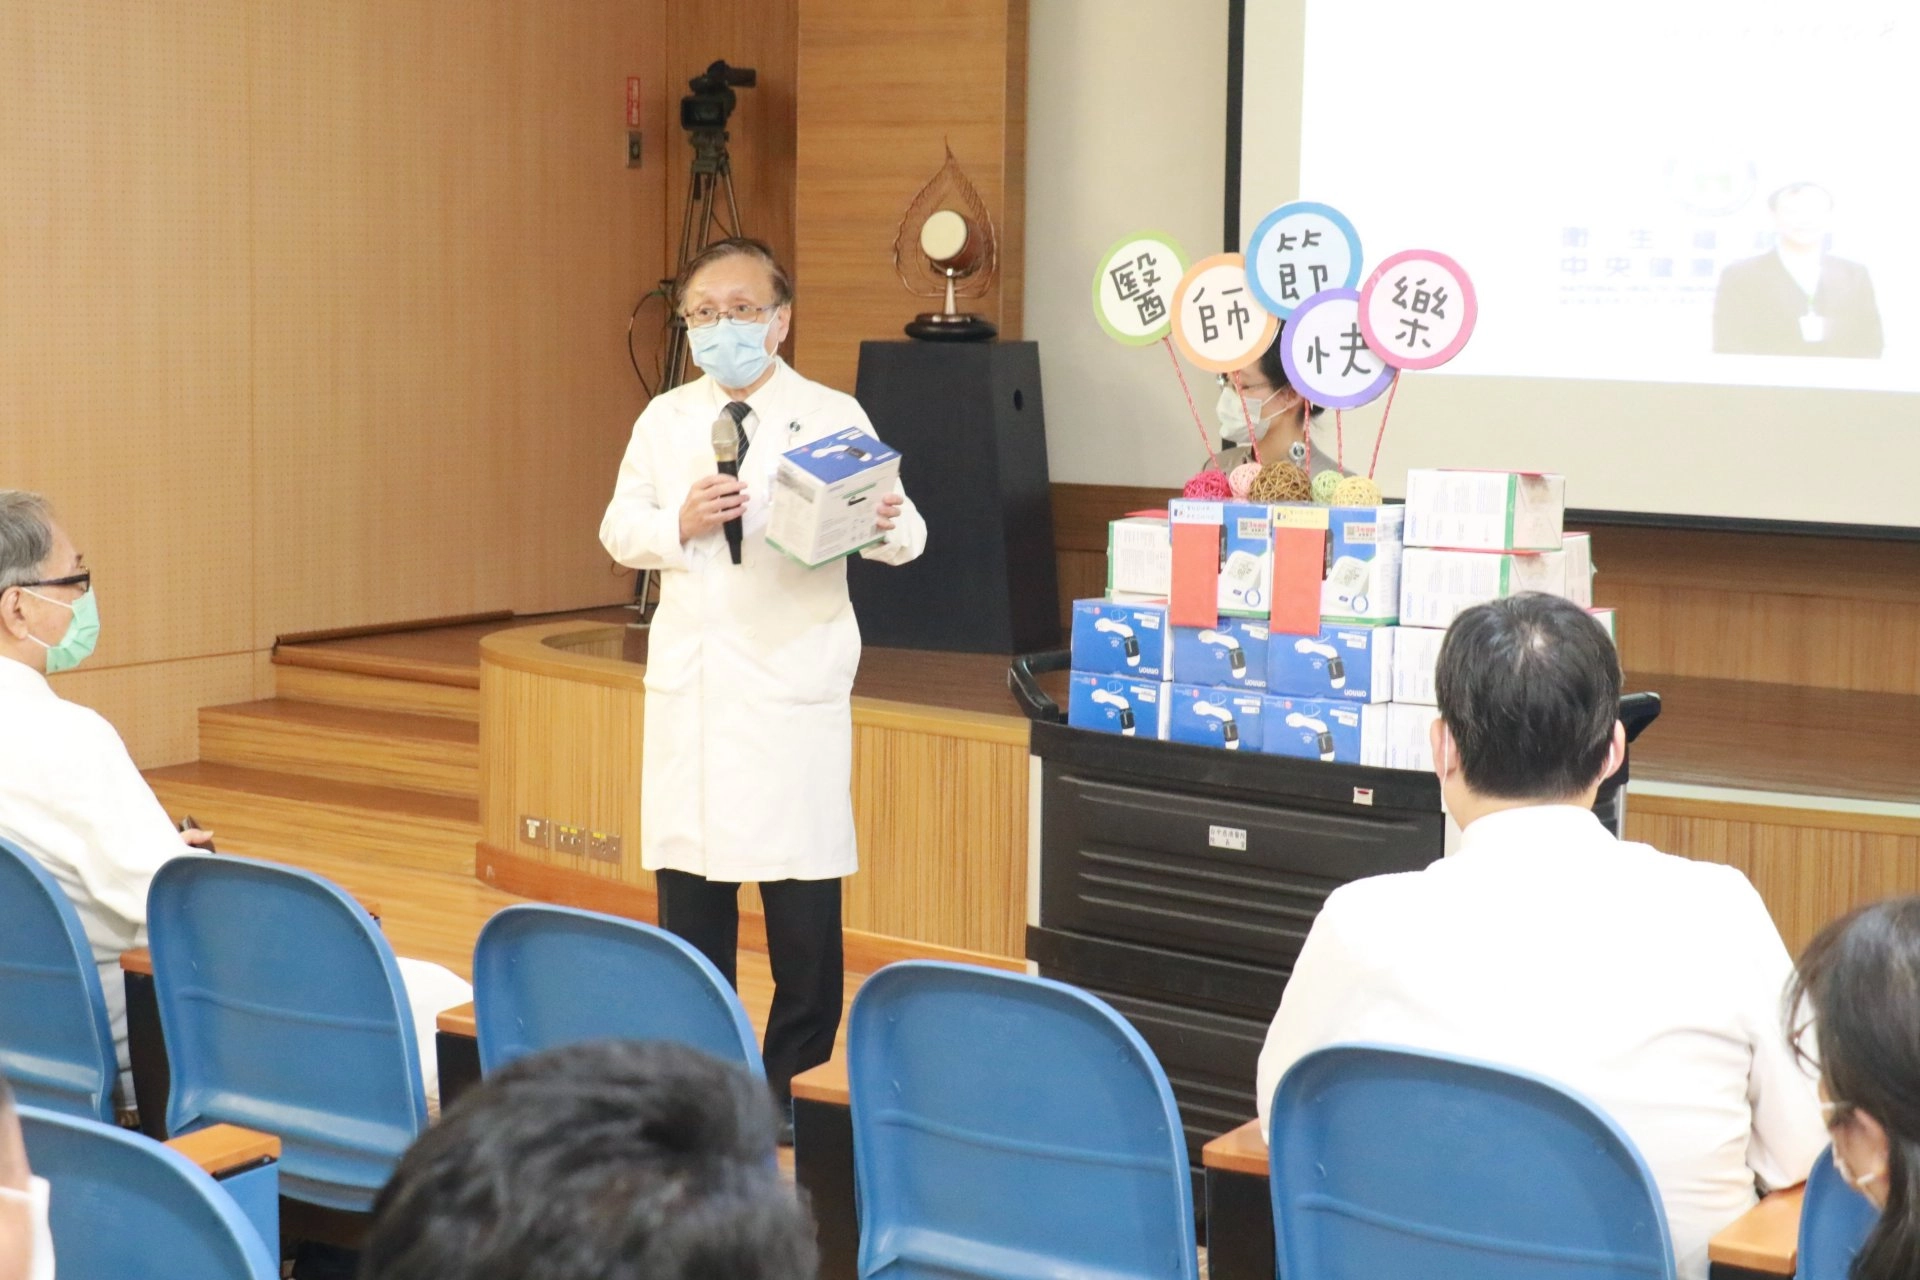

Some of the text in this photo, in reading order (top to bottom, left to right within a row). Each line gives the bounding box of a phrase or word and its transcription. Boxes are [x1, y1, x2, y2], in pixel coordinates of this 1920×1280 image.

[1109, 252, 1168, 326] 醫
[1276, 228, 1330, 301] 節
[1192, 286, 1251, 344] 師
[1390, 275, 1449, 350] 樂
[1306, 321, 1373, 379] 快
